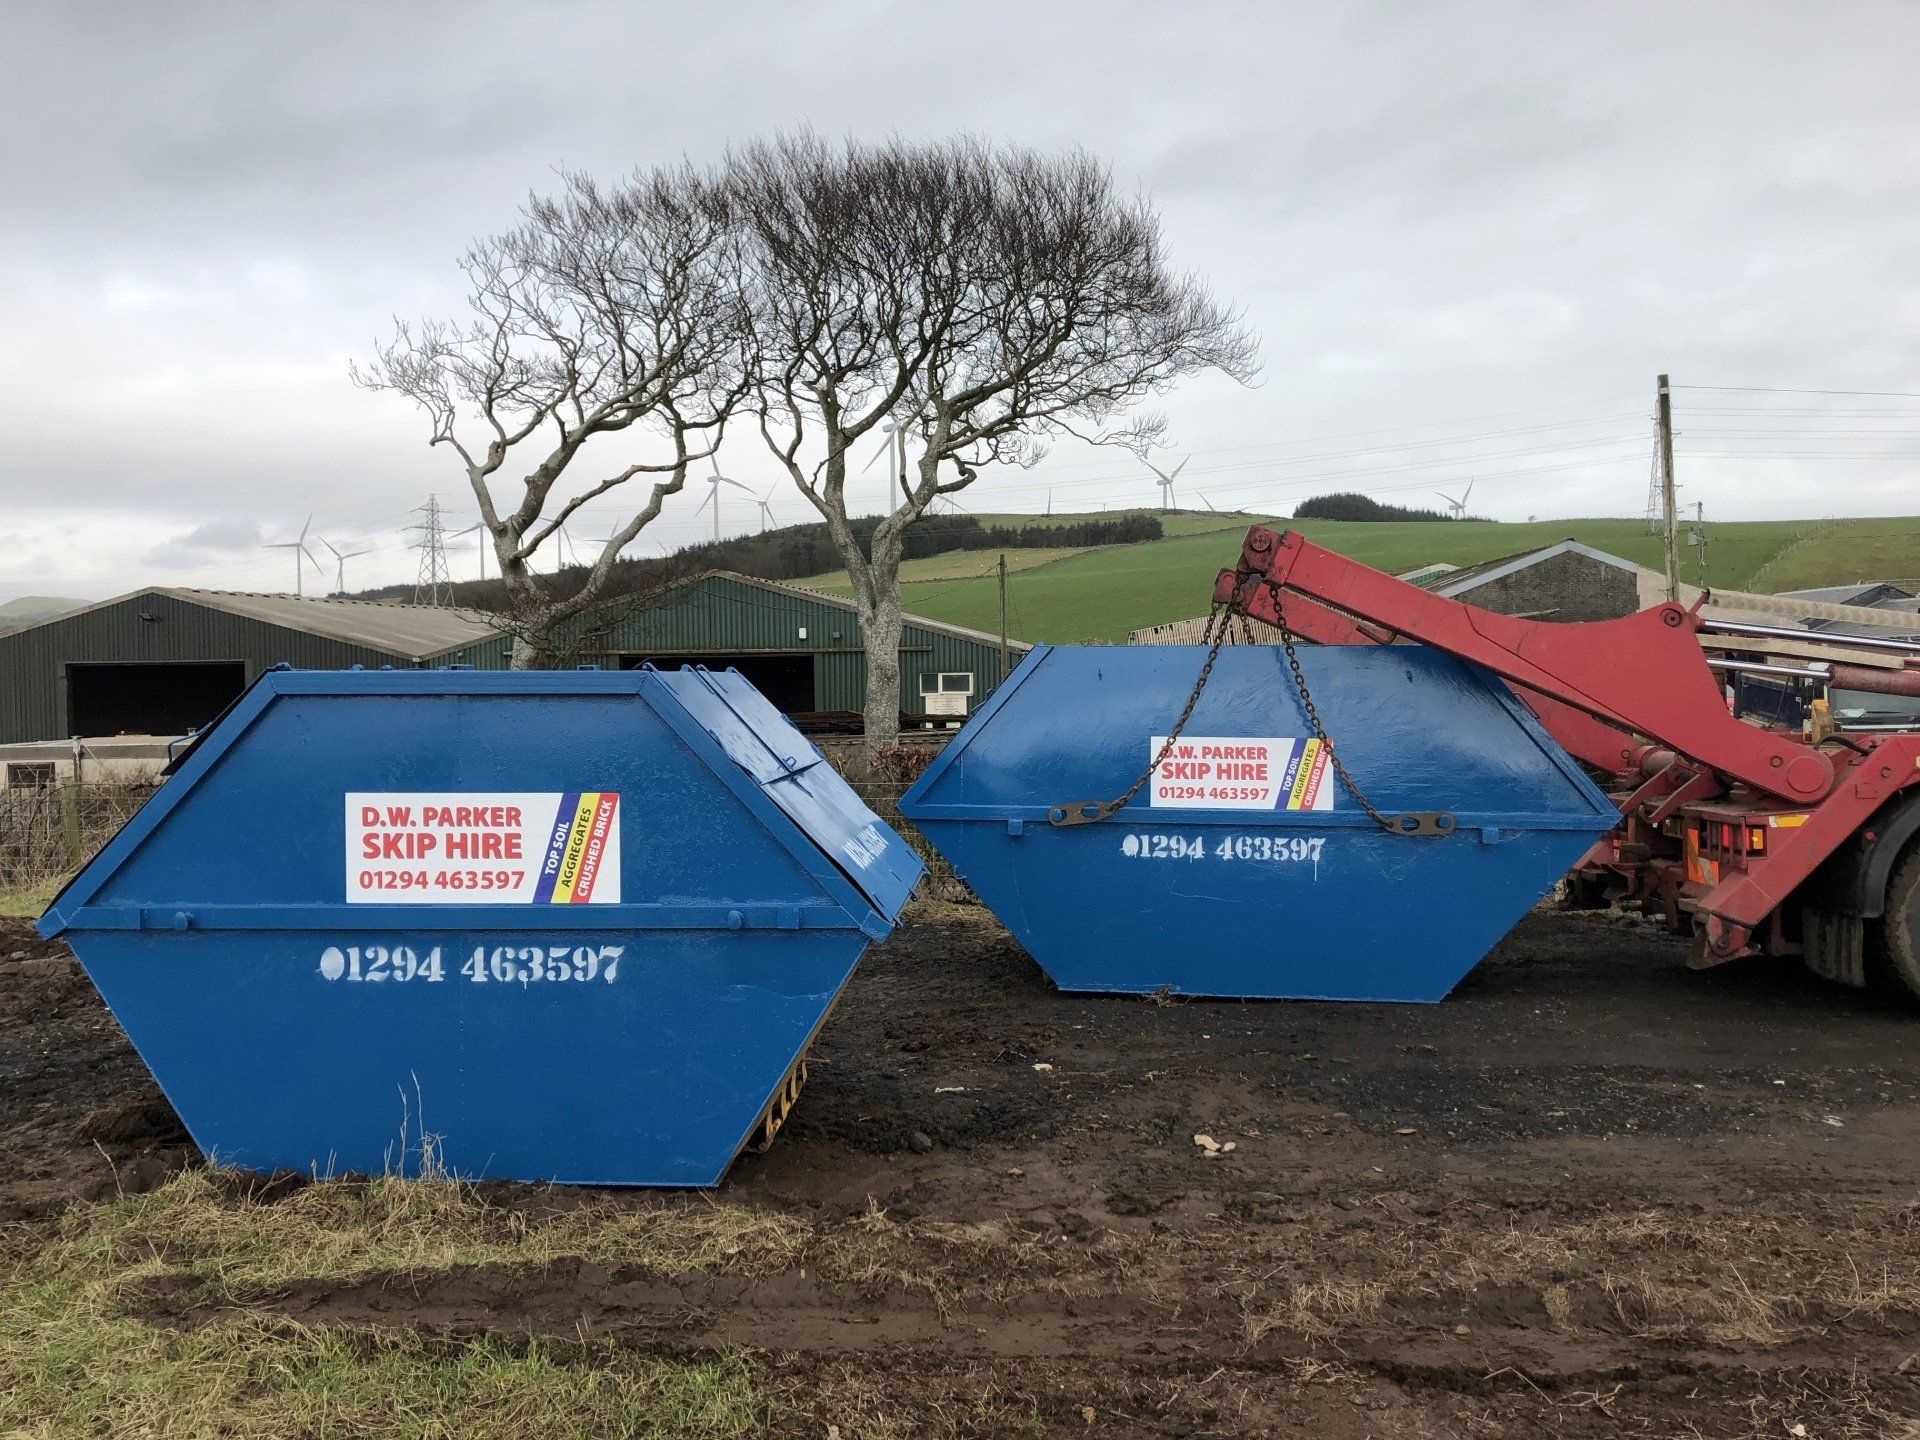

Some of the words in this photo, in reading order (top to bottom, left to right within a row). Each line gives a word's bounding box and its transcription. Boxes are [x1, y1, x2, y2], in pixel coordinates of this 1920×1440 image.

[1201, 746, 1268, 760] PARKER
[1161, 761, 1211, 780] SKIP
[1216, 763, 1268, 781] HIRE
[1282, 775, 1293, 791] TOP
[1288, 757, 1300, 775] SOIL
[1293, 748, 1315, 800] AGGREGATES
[1304, 768, 1321, 806] CRUSHED
[1315, 742, 1327, 768] BRIC
[1159, 786, 1206, 799] 01294
[1209, 787, 1270, 800] 463597
[361, 806, 417, 828] D.W.
[422, 806, 522, 828] PARKER
[362, 832, 437, 860] SKIP
[445, 832, 523, 860] HIRE
[544, 849, 560, 875] TOP
[552, 821, 570, 850] SOIL
[561, 807, 592, 888] AGGREGATES
[577, 838, 601, 897] CRUSHED
[593, 799, 613, 838] BRICK
[1122, 833, 1206, 860] 01294
[1215, 836, 1327, 863] 463597
[359, 870, 429, 890] 01294
[434, 870, 525, 890] 463597
[319, 945, 446, 982] 01294
[460, 945, 626, 985] 463597
